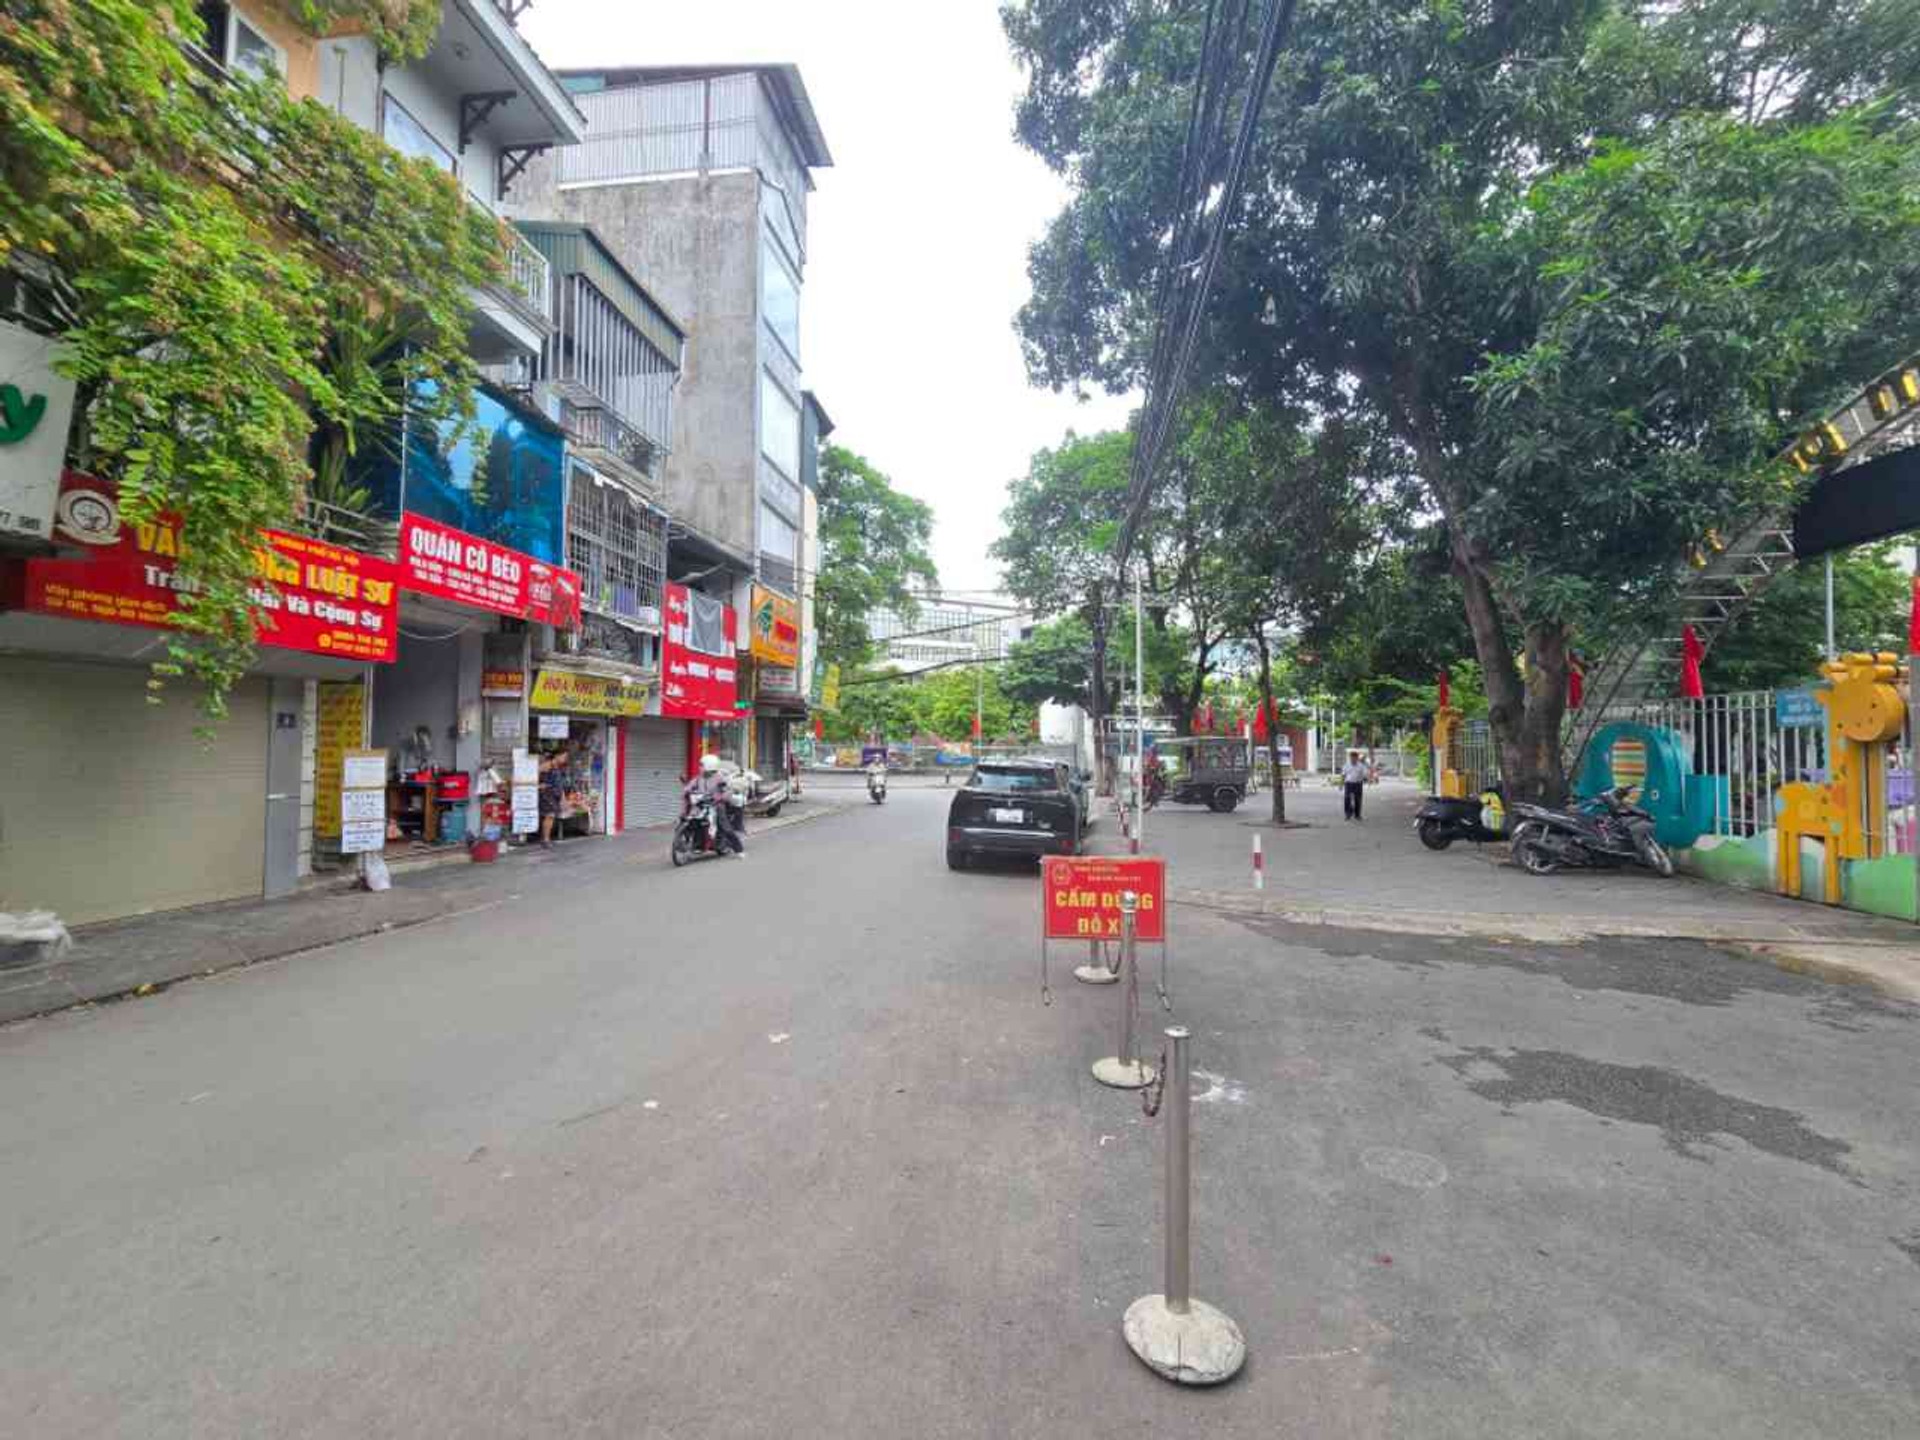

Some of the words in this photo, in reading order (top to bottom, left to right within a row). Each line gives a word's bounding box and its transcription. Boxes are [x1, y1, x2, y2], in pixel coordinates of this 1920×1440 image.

[410, 526, 462, 565] QUÁN
[491, 553, 522, 584] BÉO
[306, 563, 360, 600] LUẬT
[363, 577, 394, 606] SƯ
[286, 593, 310, 615] Và
[313, 600, 356, 626] Cộng
[360, 610, 384, 632] Sự
[1056, 885, 1097, 908] CẤM
